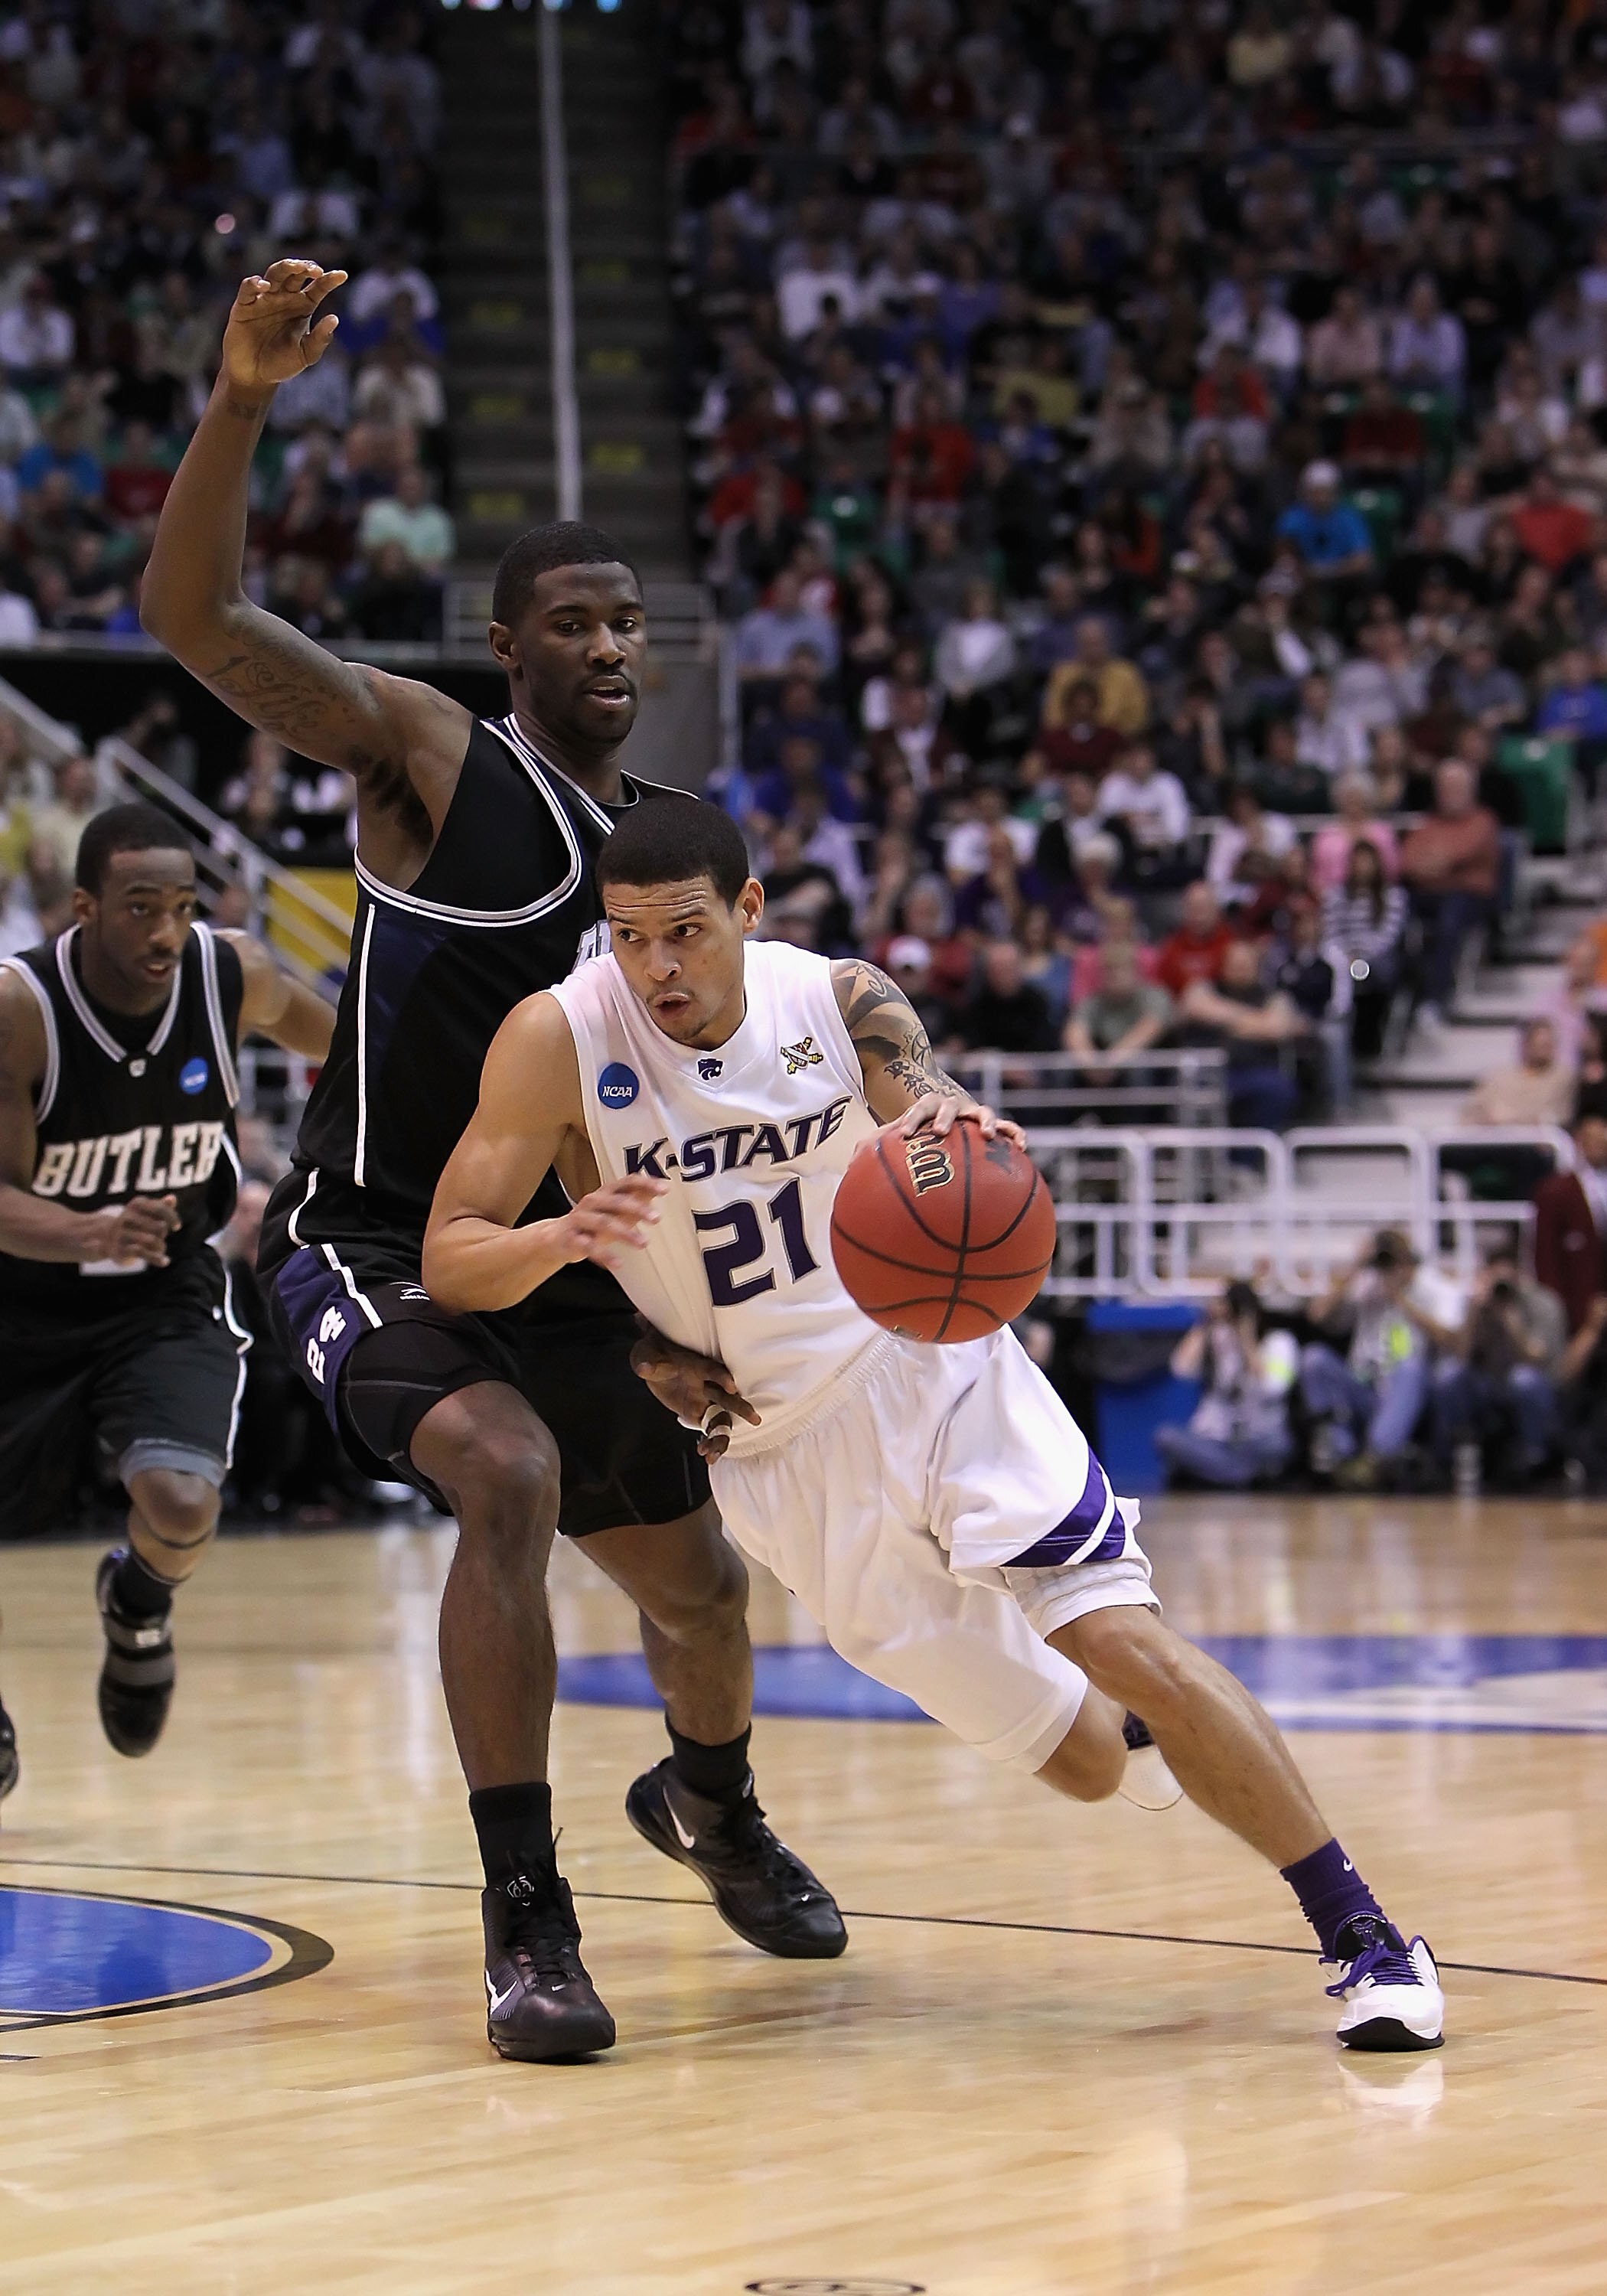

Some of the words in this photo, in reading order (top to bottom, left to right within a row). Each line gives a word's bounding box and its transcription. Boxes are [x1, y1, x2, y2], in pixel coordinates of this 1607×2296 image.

[601, 1084, 633, 1098] NCAA
[31, 1120, 224, 1198] BUTLER
[623, 1095, 853, 1182] K-STATE
[691, 1176, 822, 1309] 21
